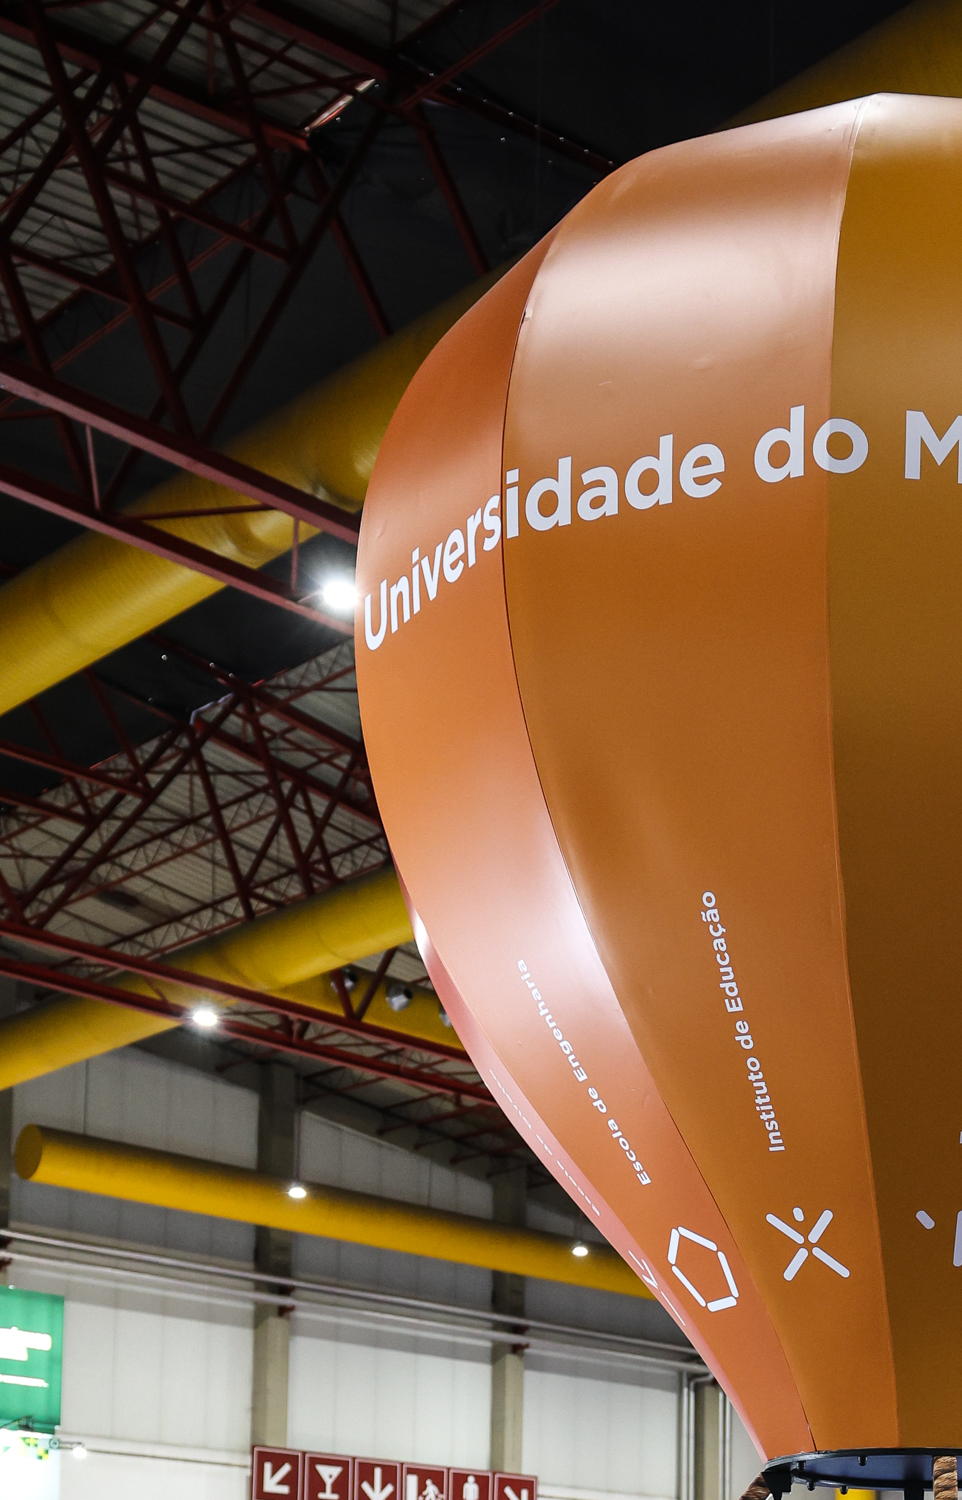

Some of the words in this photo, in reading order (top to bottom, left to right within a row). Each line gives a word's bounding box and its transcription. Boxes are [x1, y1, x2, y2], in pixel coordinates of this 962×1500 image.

[364, 433, 726, 651] Universidade
[753, 404, 869, 484] do
[700, 890, 744, 1014] Educação
[516, 957, 588, 1083] Engenharia
[734, 1019, 755, 1051] de
[587, 1086, 608, 1115] de
[746, 1055, 786, 1152] Instituto
[607, 1117, 652, 1187] Escola
